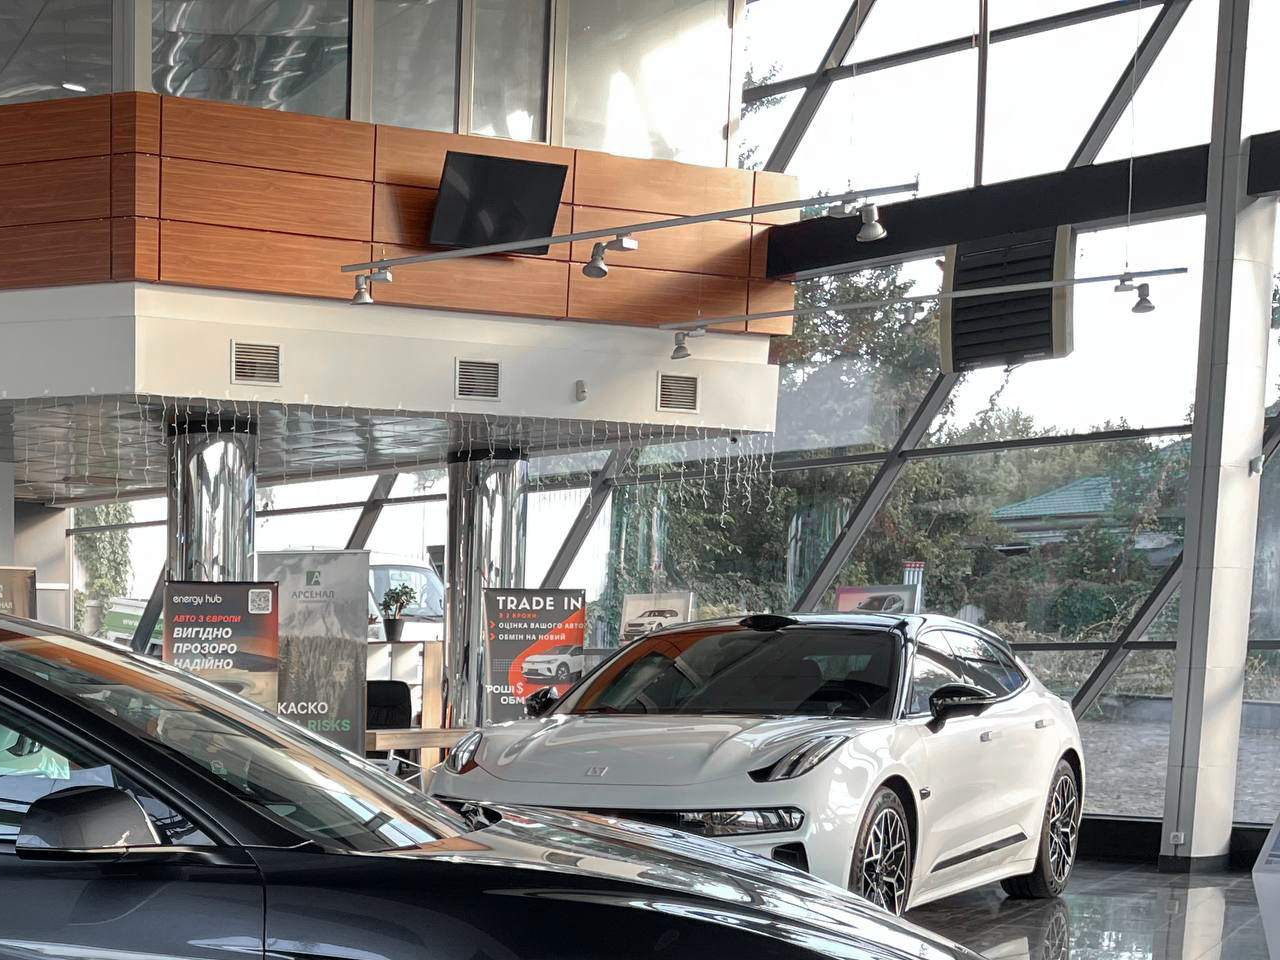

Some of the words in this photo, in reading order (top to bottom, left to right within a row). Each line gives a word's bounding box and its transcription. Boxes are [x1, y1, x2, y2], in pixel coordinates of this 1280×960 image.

[172, 595, 203, 605] energy
[205, 594, 222, 603] hub
[291, 591, 335, 599] АРСЕНАЛ
[496, 596, 555, 610] TRADE
[564, 596, 582, 610] IN
[498, 622, 528, 630] ОЦІНКА
[173, 627, 233, 640] ВИГІДНО
[173, 643, 237, 654] ПРОЗОРО
[174, 656, 233, 670] НАДІЙНО
[500, 696, 526, 705] ОБМ
[277, 702, 329, 715] КАСКО
[307, 719, 351, 732] RISKS
